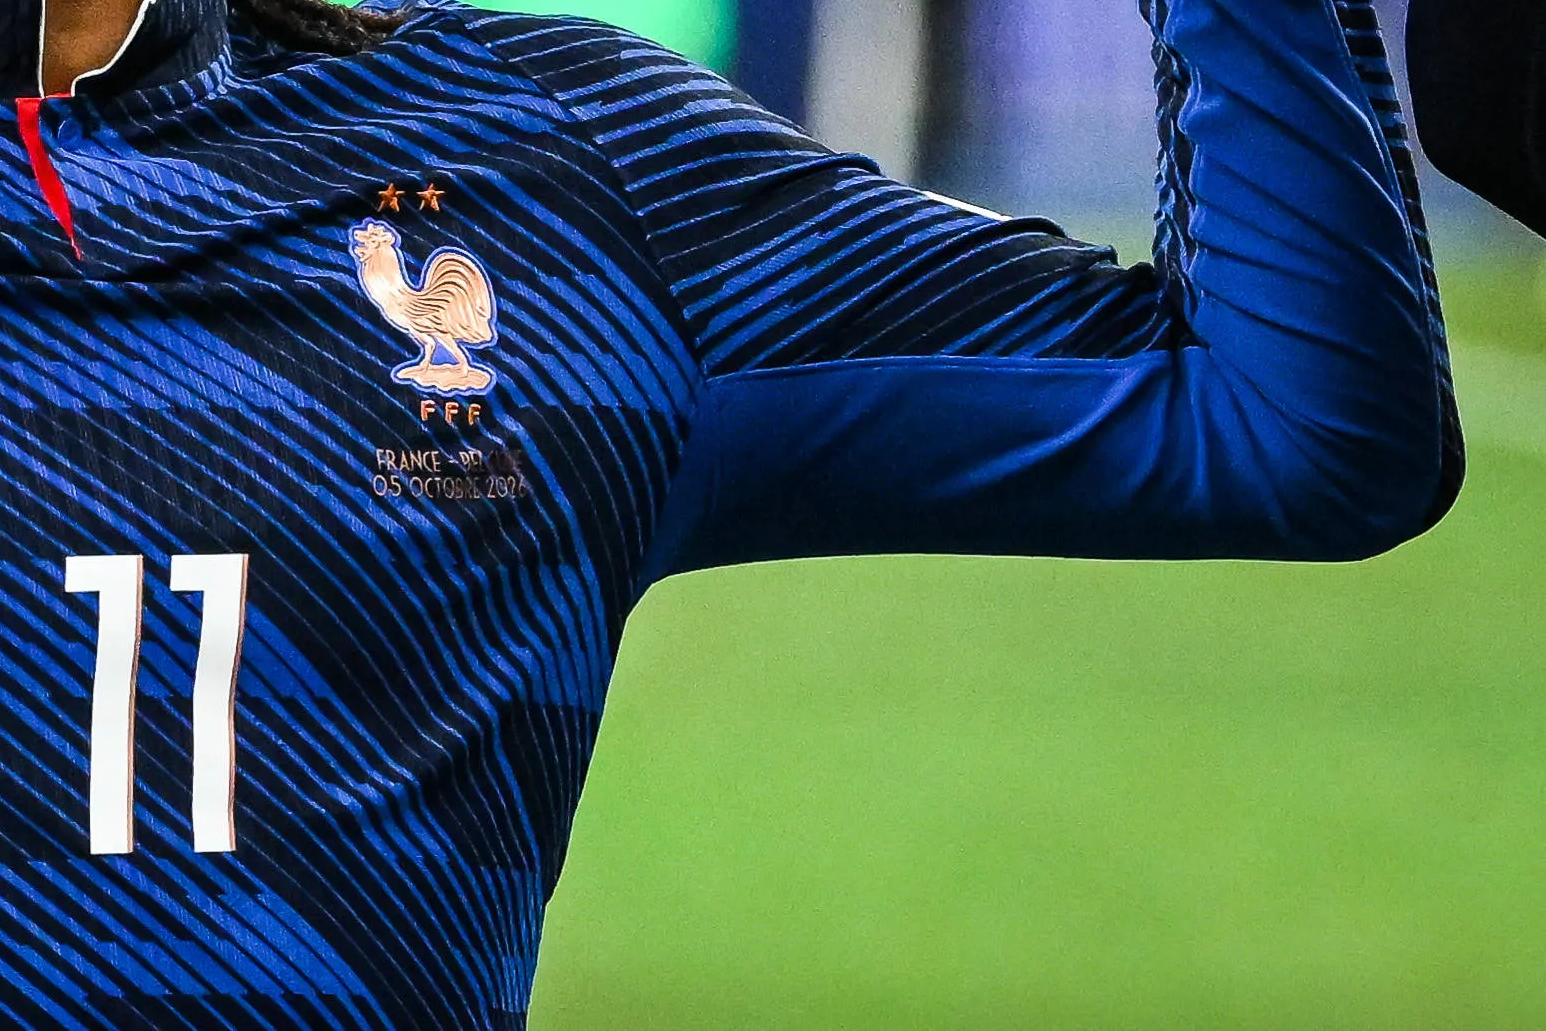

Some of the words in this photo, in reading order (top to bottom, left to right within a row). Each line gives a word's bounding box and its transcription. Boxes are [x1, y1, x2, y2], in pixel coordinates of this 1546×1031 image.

[376, 449, 441, 472] FRANCE
[373, 474, 402, 497] 05
[409, 476, 481, 499] OCTOBRE
[65, 553, 249, 855] 11
